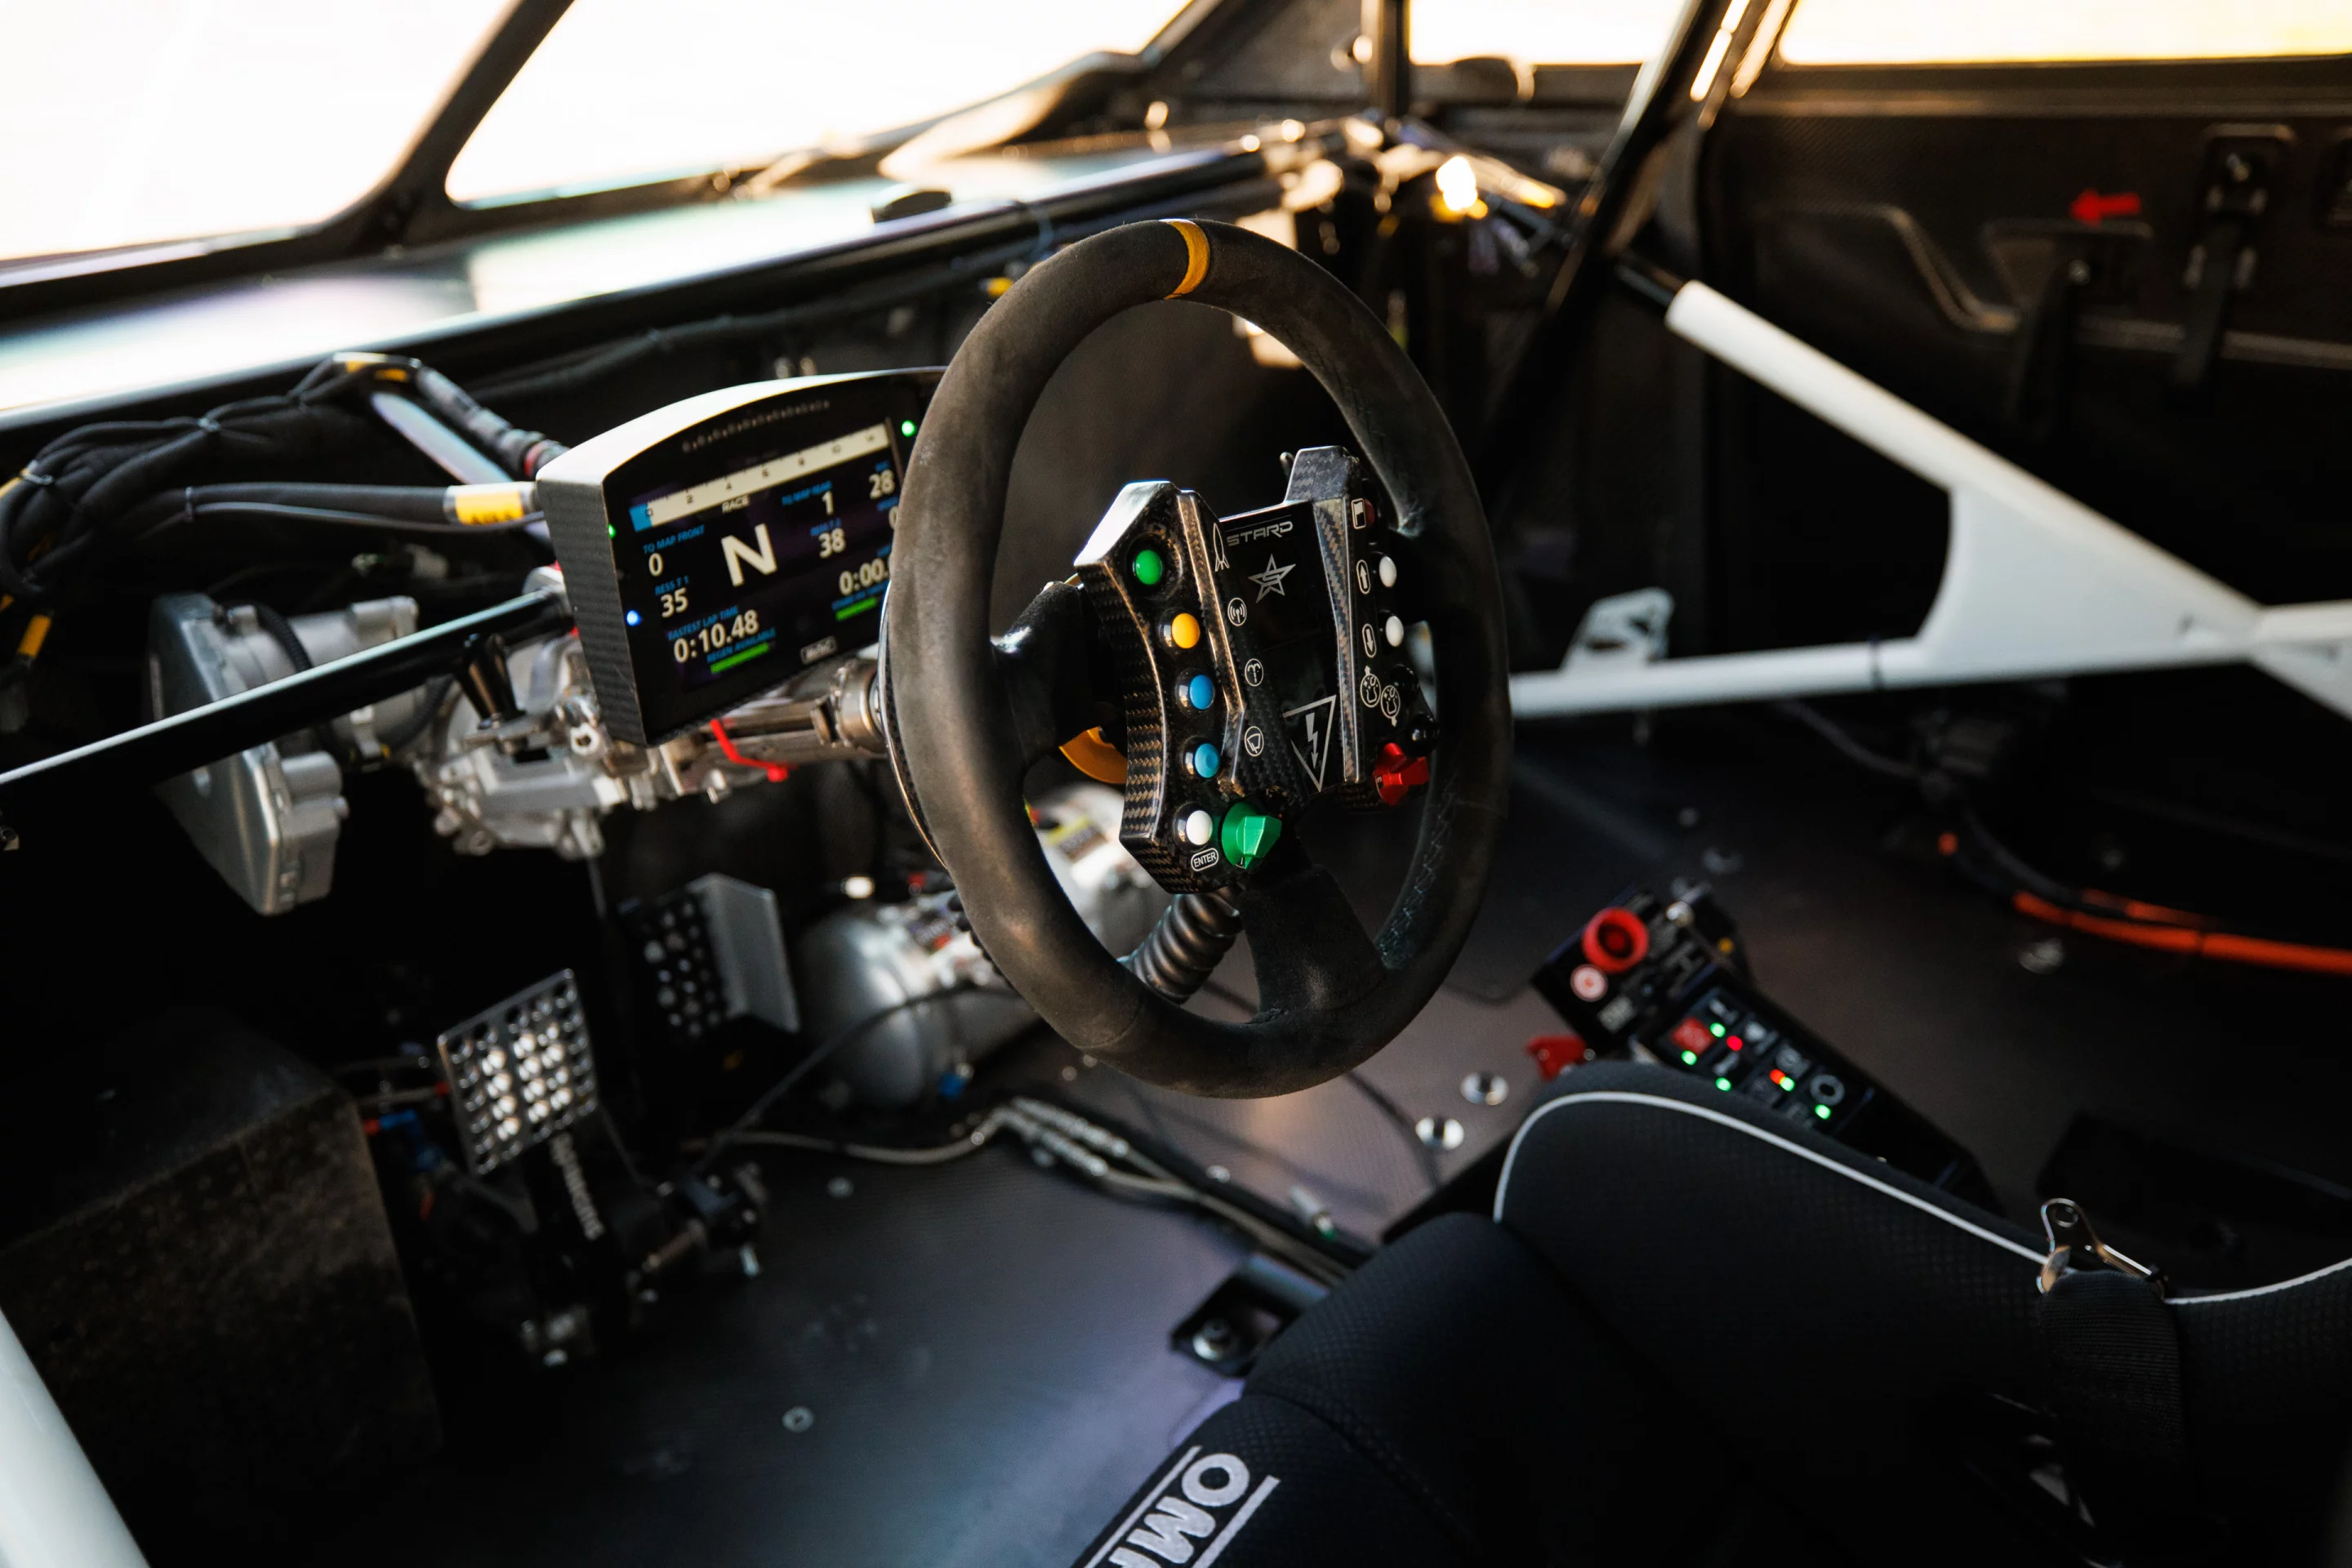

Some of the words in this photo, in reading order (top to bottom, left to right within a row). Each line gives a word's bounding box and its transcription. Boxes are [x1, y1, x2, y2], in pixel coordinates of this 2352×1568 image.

[868, 469, 896, 500] 28
[722, 495, 750, 514] RACE
[822, 490, 834, 516] 1
[656, 535, 676, 550] MAP
[818, 528, 846, 558] 38
[1227, 521, 1294, 547] STARD
[648, 552, 663, 577] 0
[721, 523, 777, 587] N
[661, 587, 689, 618] 35
[668, 620, 702, 641] FASTEST
[702, 613, 718, 628] LAP
[719, 605, 738, 621] TIME
[674, 609, 760, 663] 0:10.48
[1193, 852, 1217, 868] ENTER
